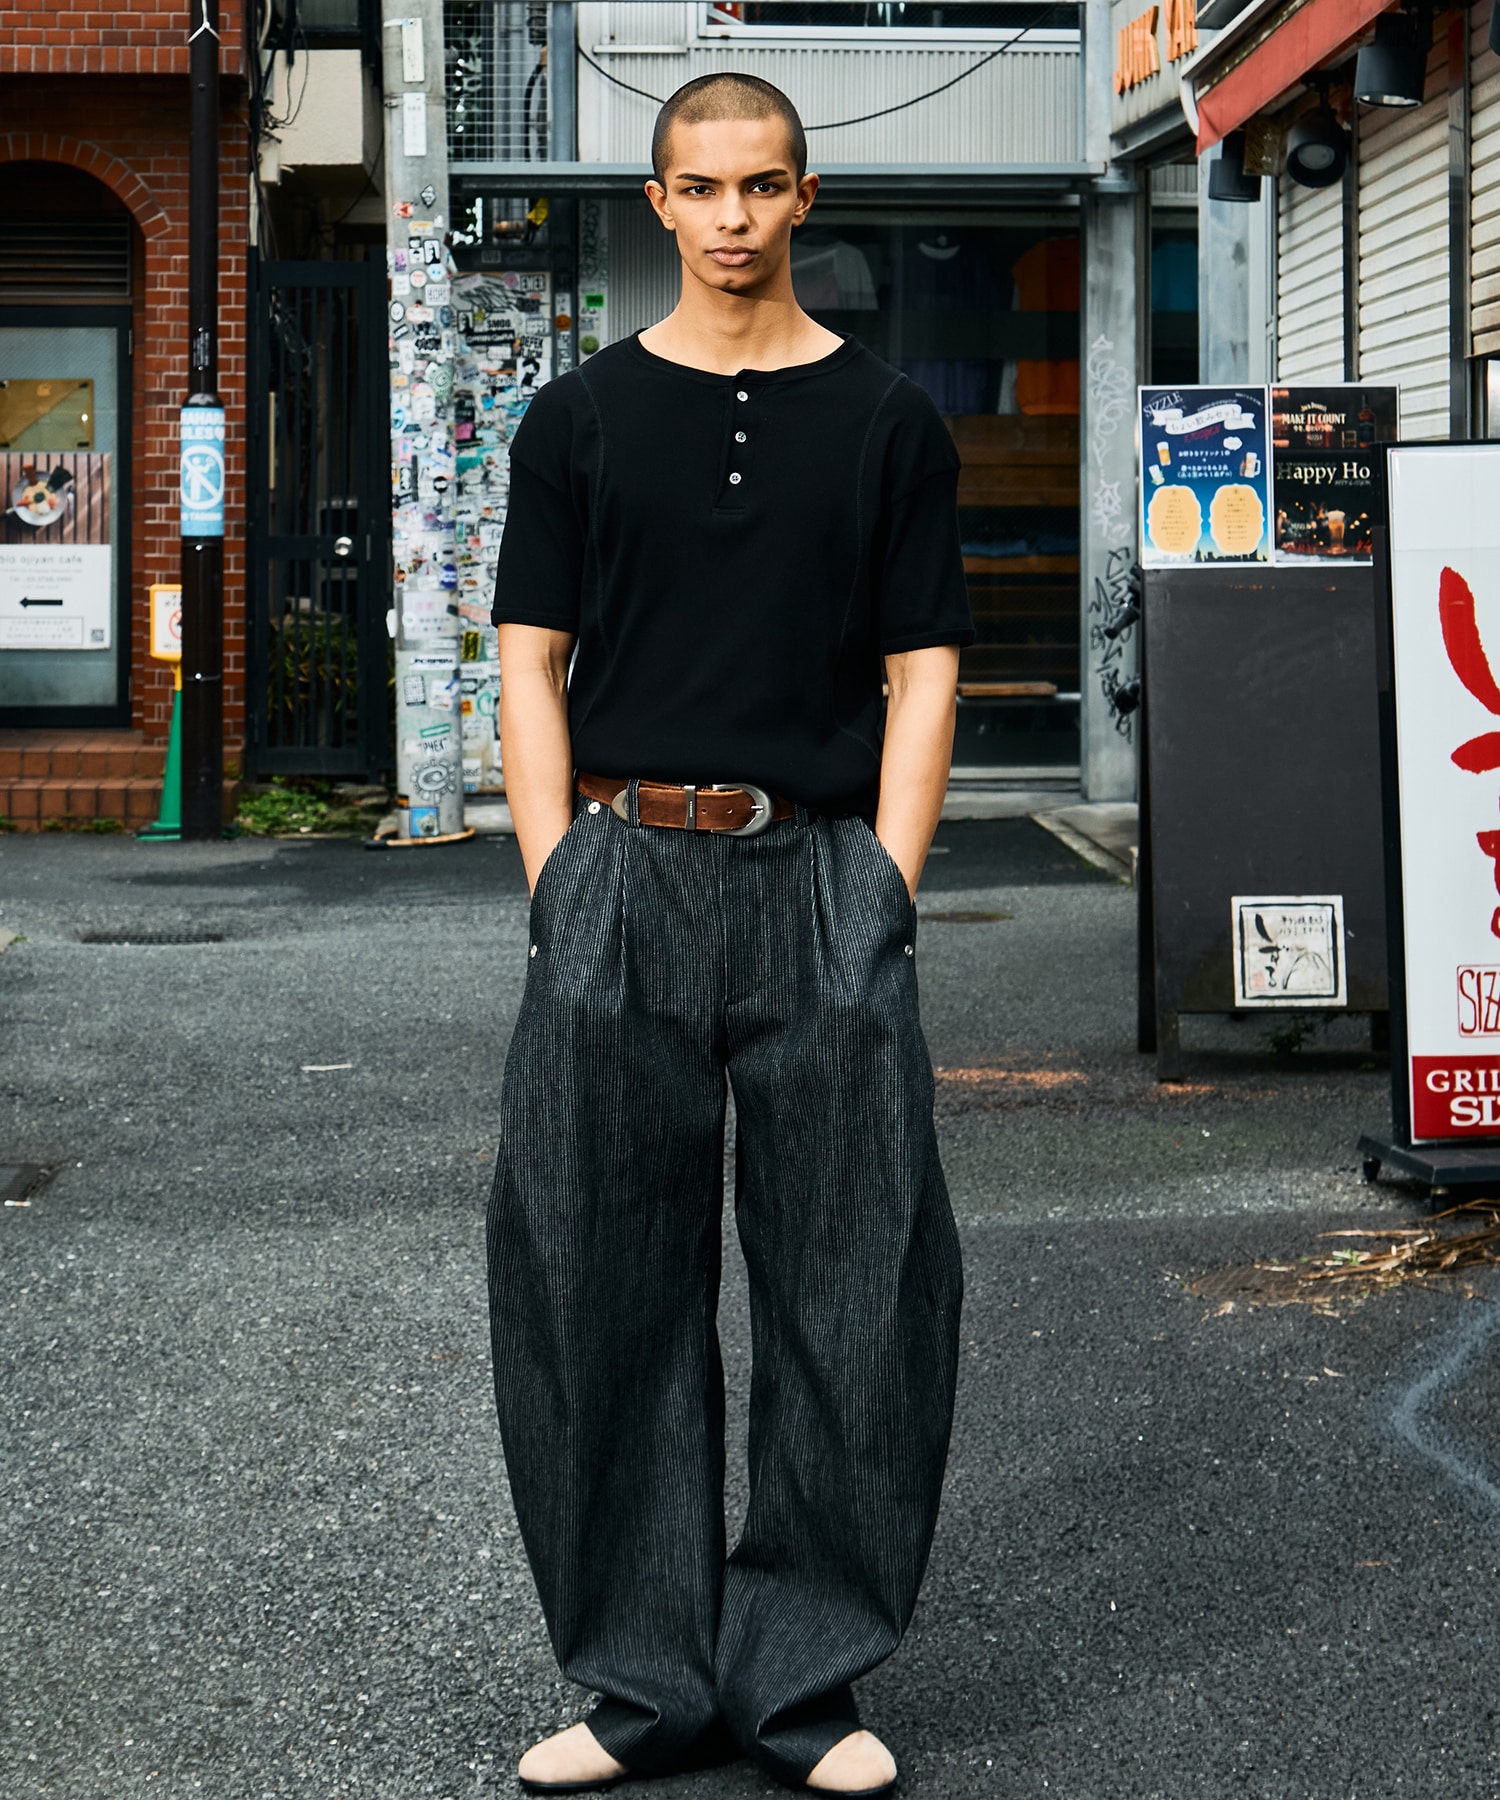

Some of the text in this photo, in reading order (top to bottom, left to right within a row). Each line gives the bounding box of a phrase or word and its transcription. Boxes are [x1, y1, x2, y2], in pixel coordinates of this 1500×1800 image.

[1142, 390, 1184, 418] SIZZLE
[1281, 413, 1347, 425] MAKE IT COUNT
[1276, 461, 1337, 485] Happy
[59, 555, 83, 564] cafe
[1254, 912, 1290, 988] しずる
[1449, 1095, 1500, 1127] SI
